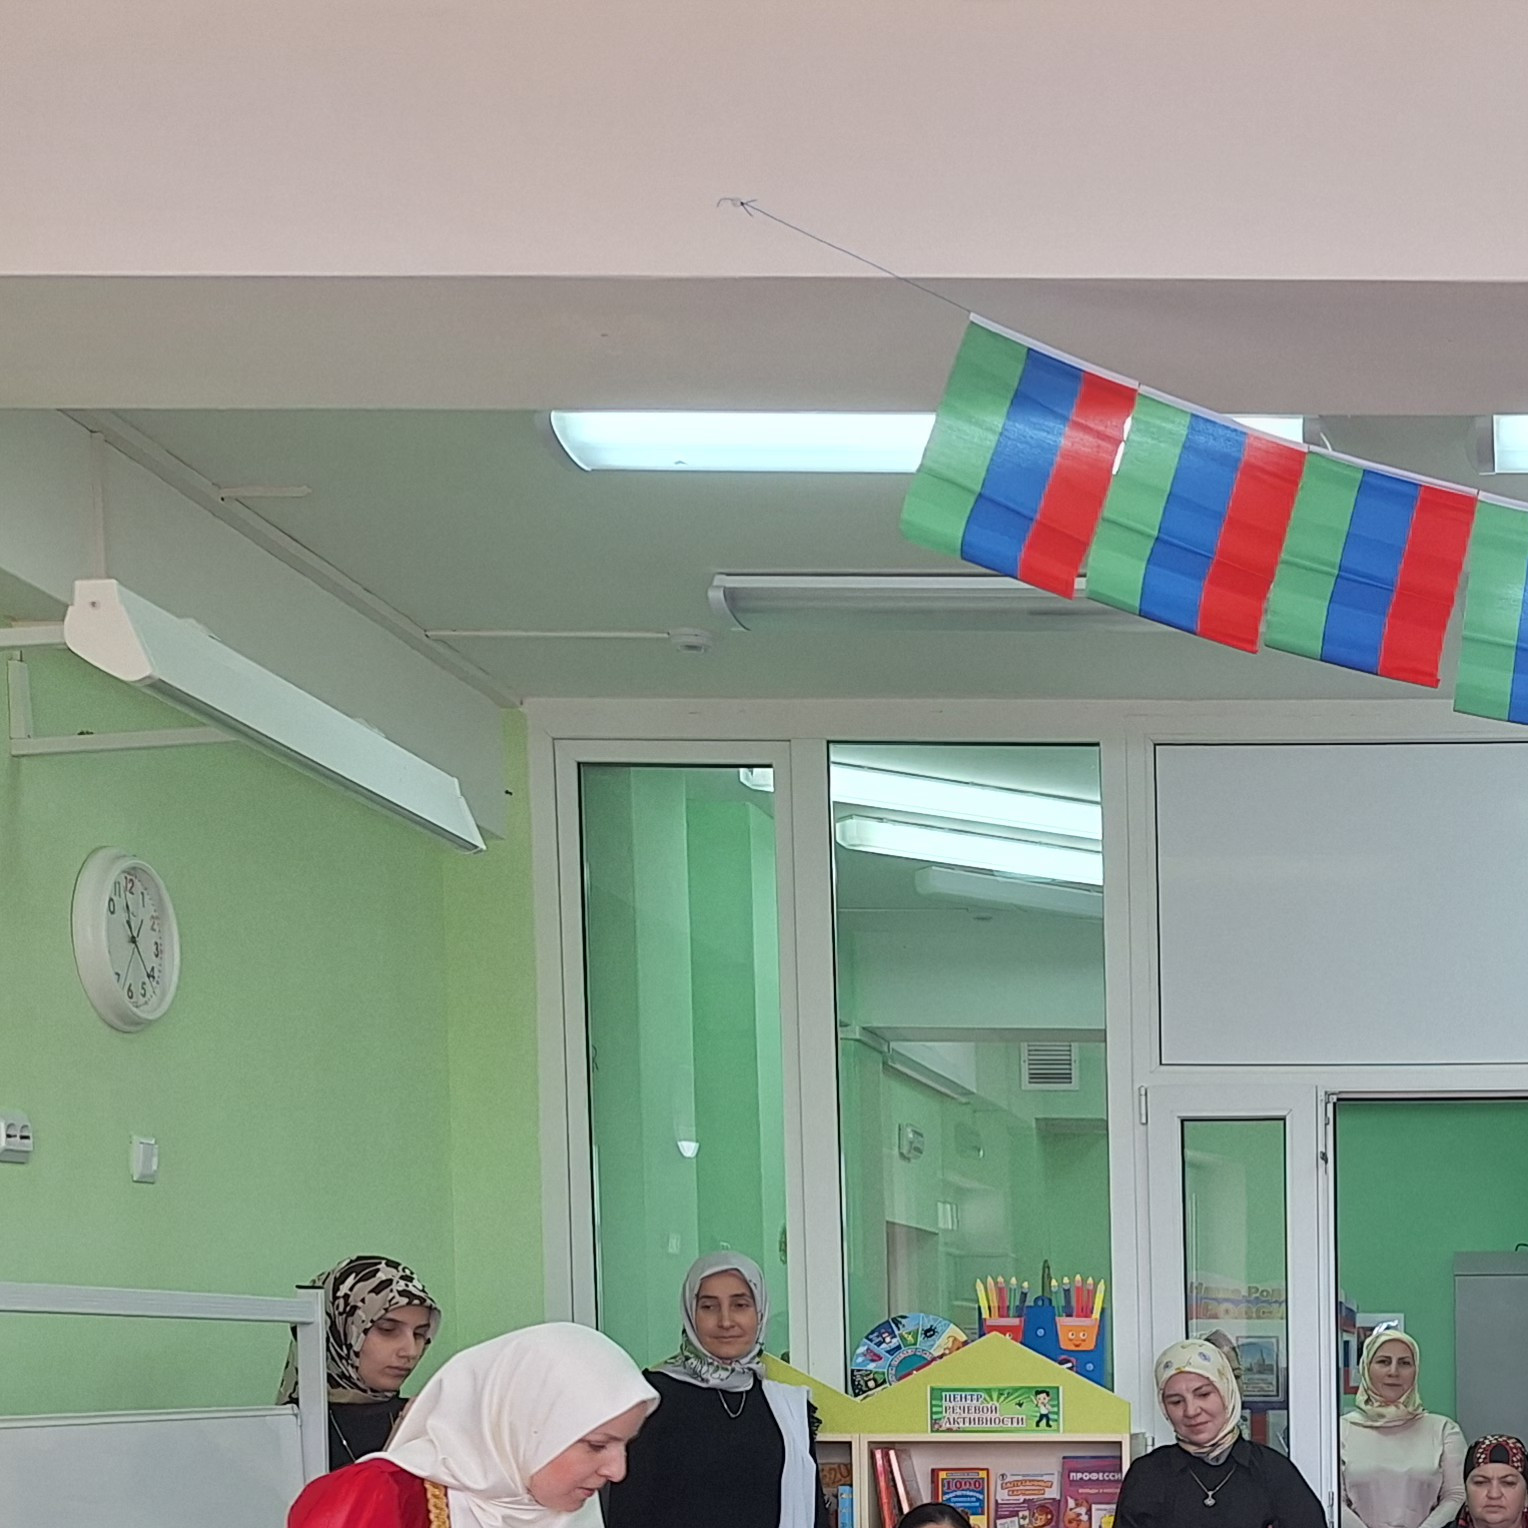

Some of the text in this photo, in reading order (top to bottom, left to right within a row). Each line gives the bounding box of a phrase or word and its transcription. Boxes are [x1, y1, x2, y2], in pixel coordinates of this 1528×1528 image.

[124, 876, 135, 895] 12
[154, 941, 159, 958] 3
[126, 982, 134, 999] 6
[139, 981, 146, 998] 5
[943, 1393, 983, 1404] ЦЕНТР
[944, 1403, 998, 1415] РЕЧЕВОЙ
[944, 1416, 1025, 1427] АКТИВНОСТИ
[945, 1479, 982, 1491] 1000
